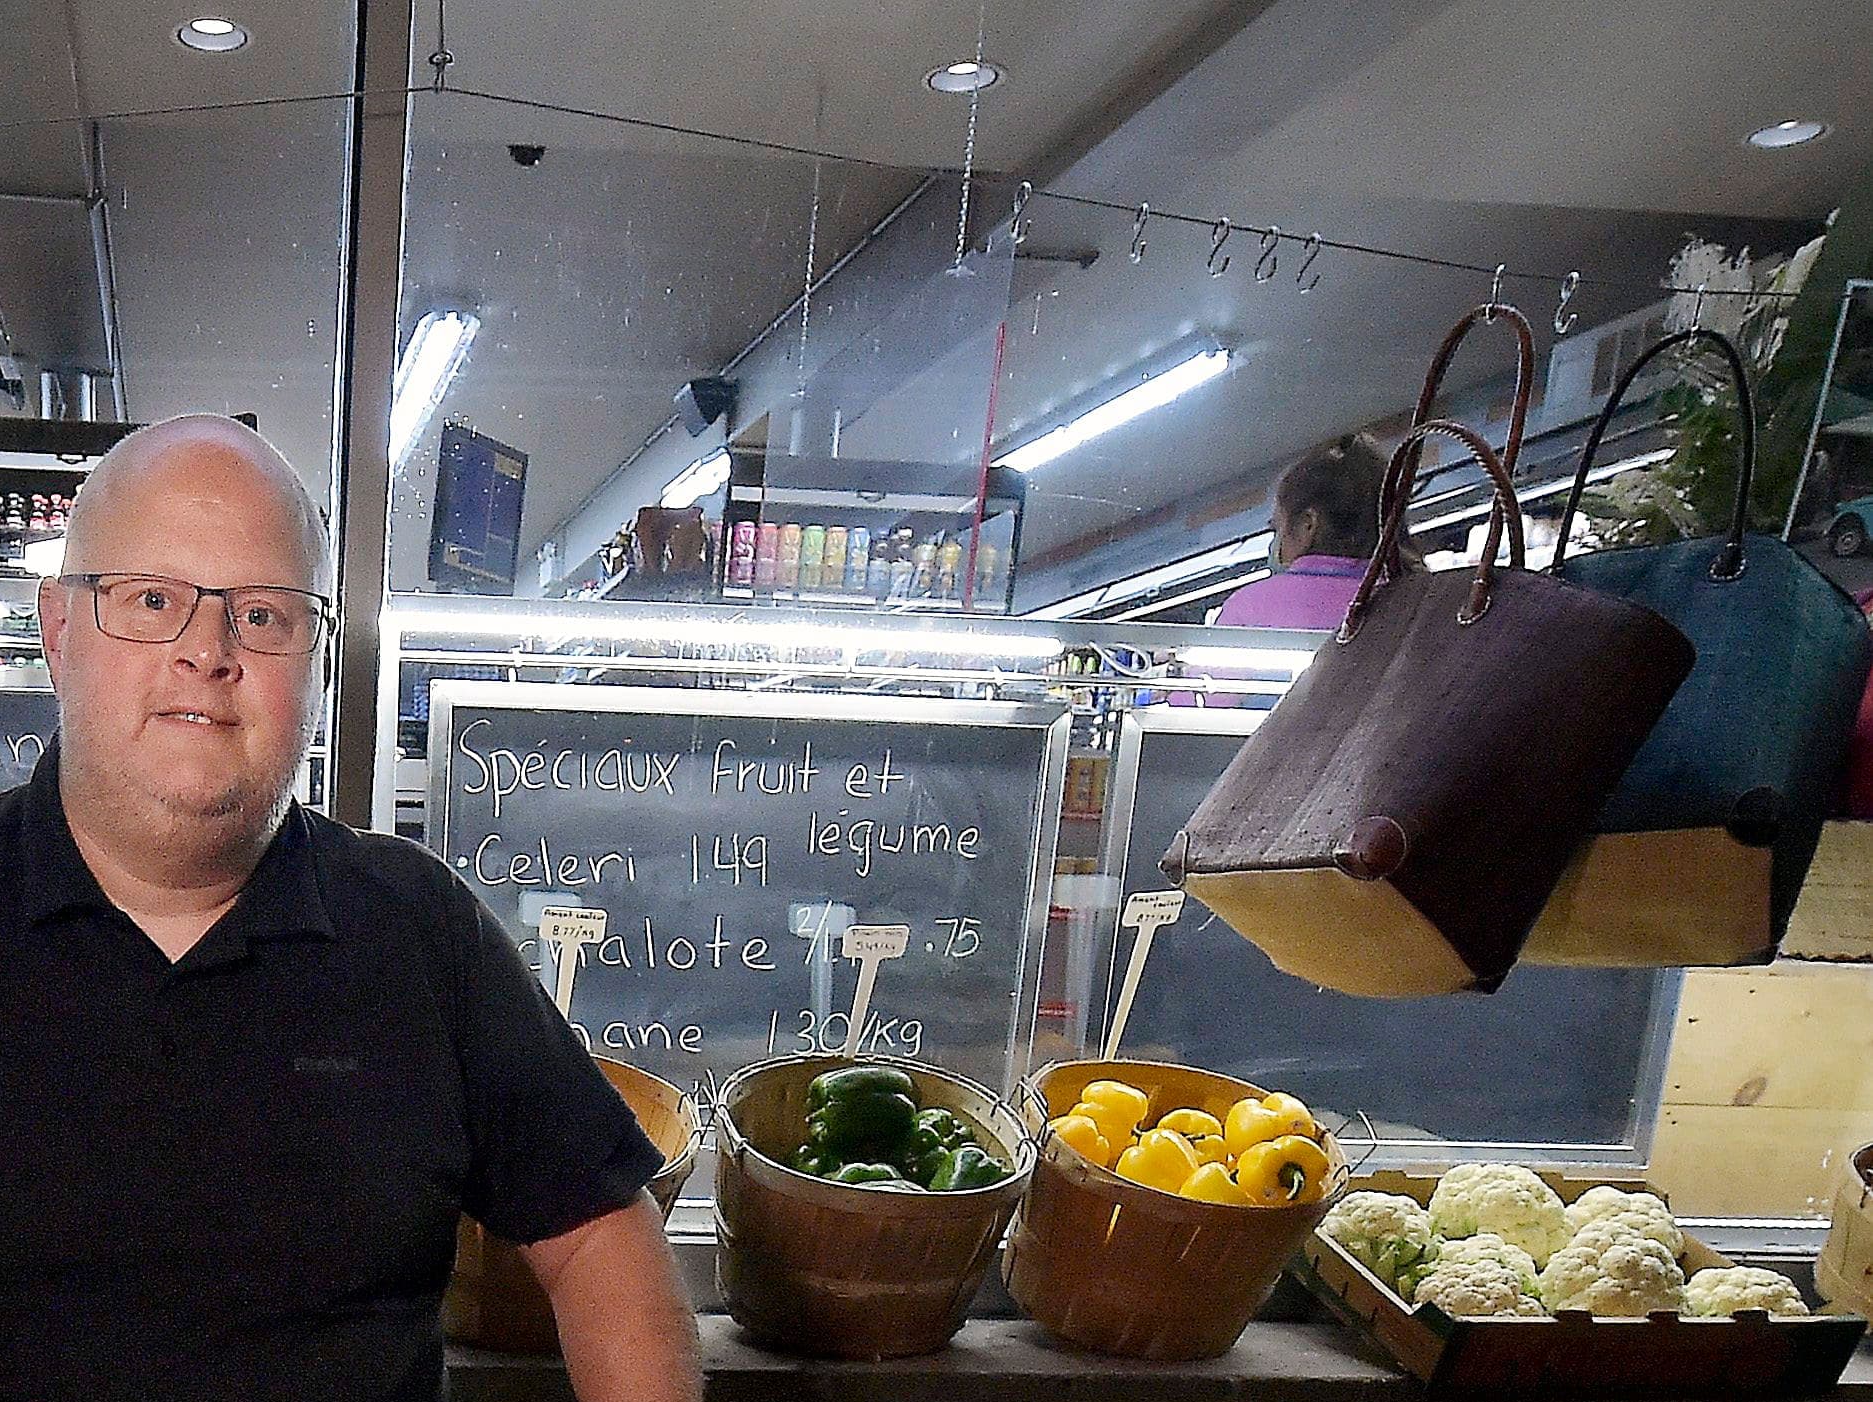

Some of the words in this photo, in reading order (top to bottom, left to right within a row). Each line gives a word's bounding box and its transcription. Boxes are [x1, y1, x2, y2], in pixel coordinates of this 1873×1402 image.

[459, 719, 680, 818] Spéciaux
[711, 738, 820, 794] fruit
[845, 749, 905, 798] et
[475, 833, 637, 886] Celeri
[809, 808, 980, 877] légume
